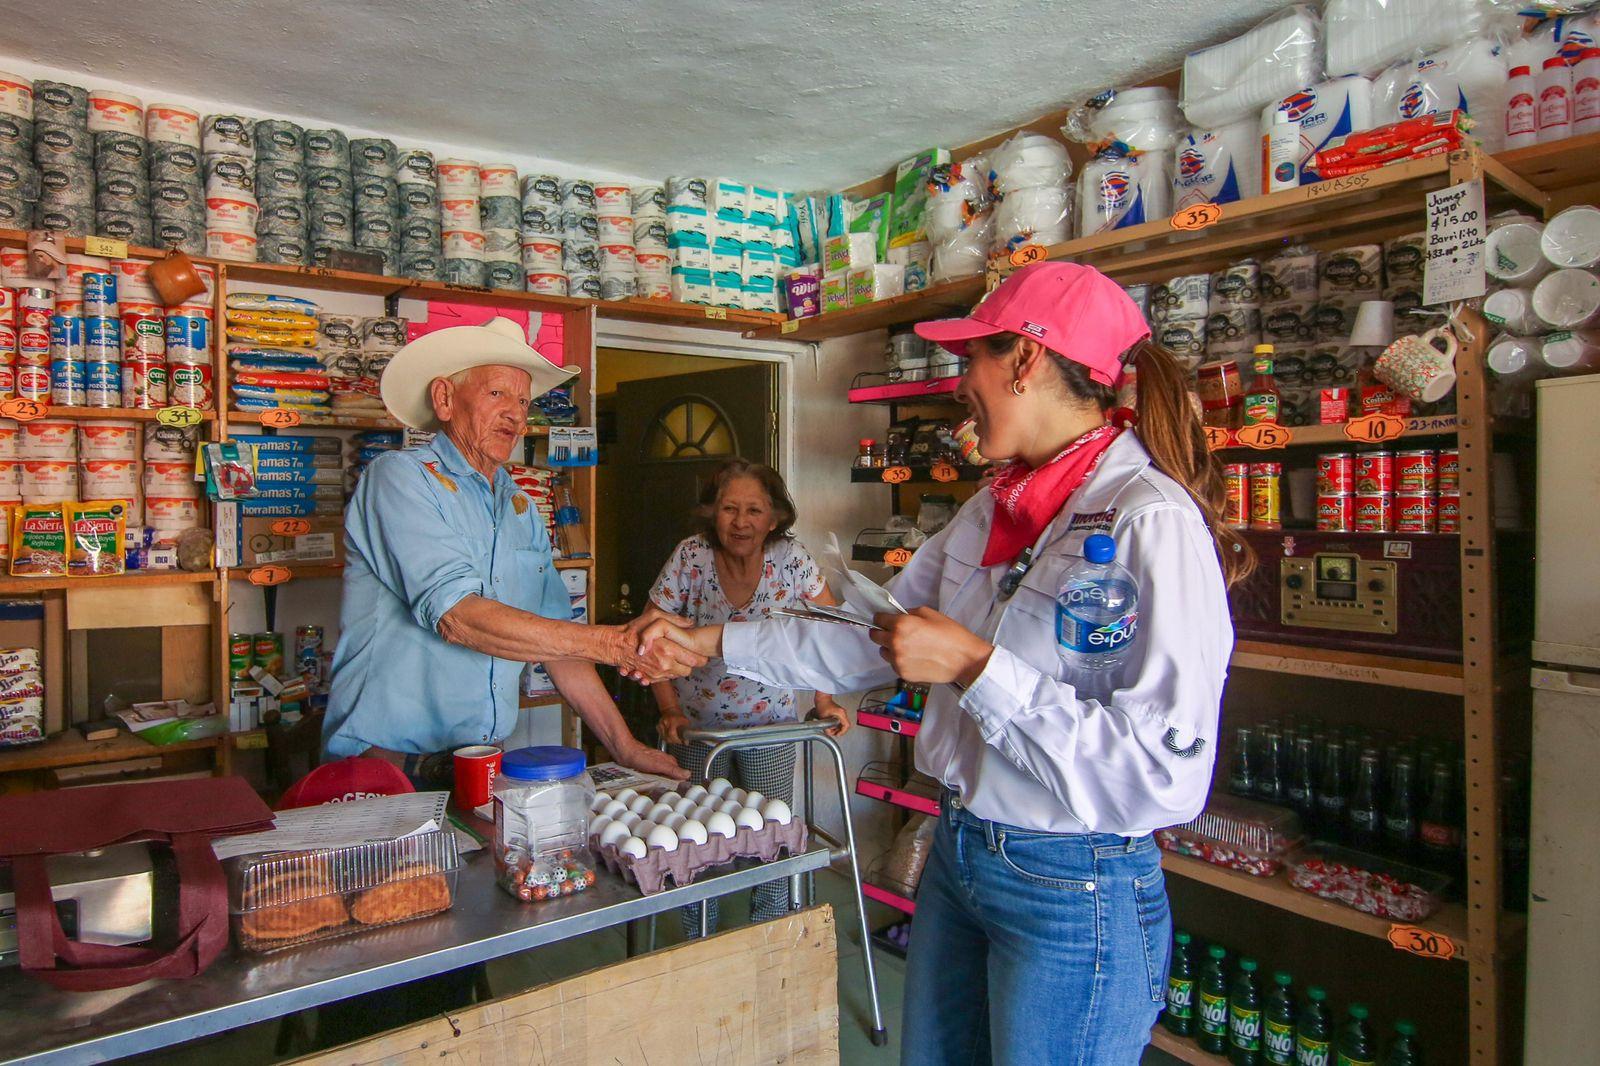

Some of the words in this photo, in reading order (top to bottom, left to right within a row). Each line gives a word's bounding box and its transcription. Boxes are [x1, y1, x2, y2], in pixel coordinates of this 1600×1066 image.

[1187, 209, 1209, 225] 35
[1022, 250, 1038, 263] 30
[17, 402, 39, 415] 23
[168, 411, 191, 423] 34
[275, 412, 292, 423] 23
[1368, 420, 1386, 438] 10
[1256, 429, 1277, 444] 15
[892, 469, 906, 480] 35
[282, 521, 300, 532] 22
[894, 552, 907, 563] 20
[1410, 932, 1438, 954] 30
